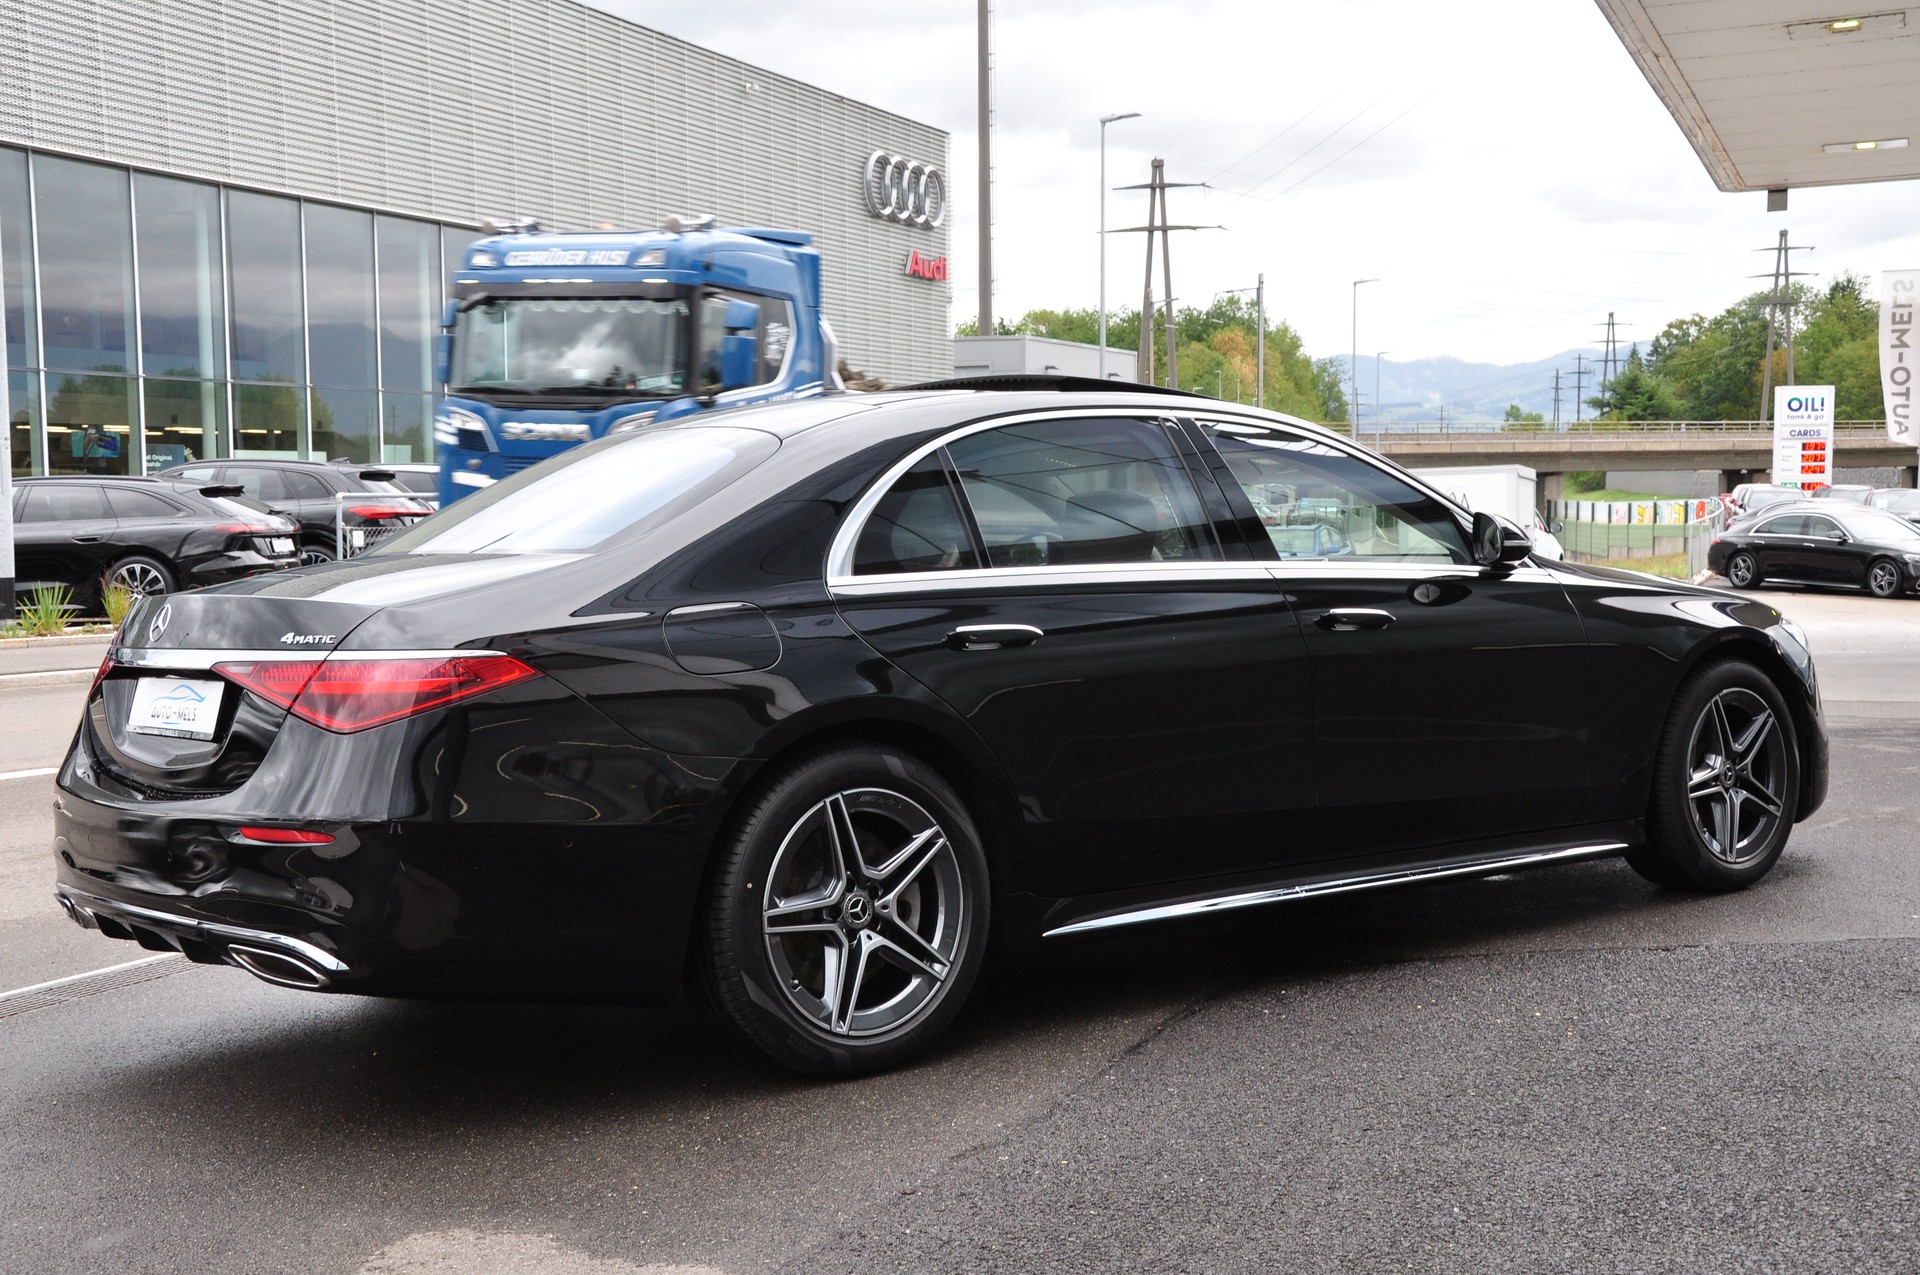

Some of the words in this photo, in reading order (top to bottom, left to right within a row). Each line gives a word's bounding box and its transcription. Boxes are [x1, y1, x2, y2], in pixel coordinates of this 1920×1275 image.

[909, 249, 947, 281] Audi
[1787, 397, 1825, 412] OIL!
[1789, 429, 1821, 437] CARDS
[280, 632, 336, 644] 4MATIC
[151, 705, 197, 721] AUTO-MELS
